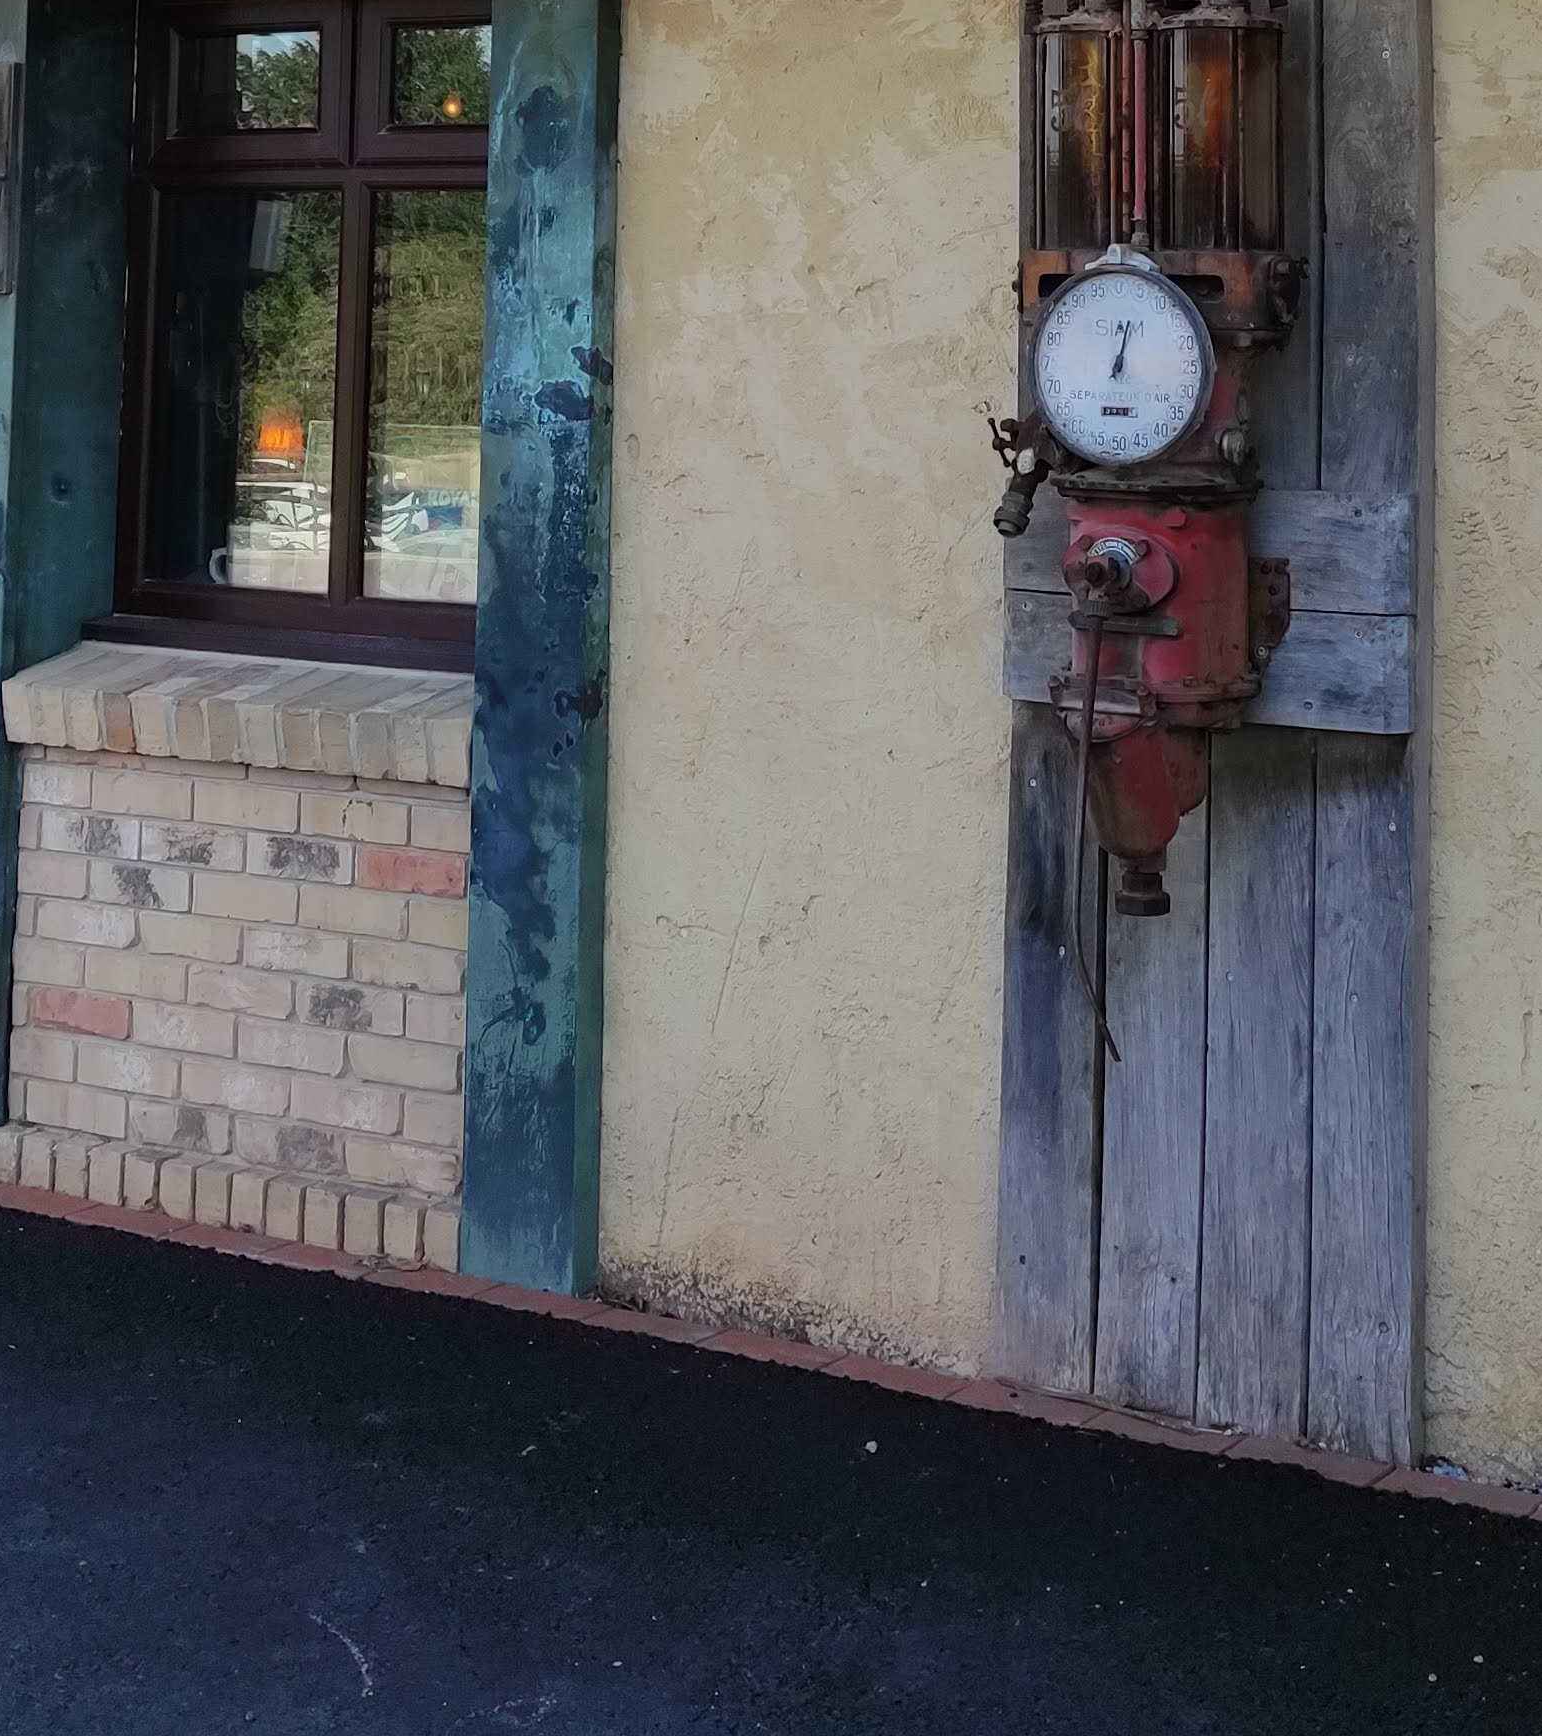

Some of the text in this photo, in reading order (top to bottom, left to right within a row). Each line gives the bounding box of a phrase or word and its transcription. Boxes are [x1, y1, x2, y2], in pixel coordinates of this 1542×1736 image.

[1090, 282, 1105, 298] 95
[1115, 279, 1123, 295] 0
[1071, 293, 1086, 308] 90
[1154, 294, 1166, 310] 10
[1056, 310, 1071, 325] 85
[1047, 331, 1061, 346] 80
[1179, 335, 1194, 351] 20
[1183, 359, 1198, 375] 25
[1047, 379, 1061, 394] 70
[1179, 384, 1194, 399] 30
[1056, 401, 1070, 417] 65
[1169, 405, 1184, 421] 35
[1153, 422, 1168, 438] 40
[1112, 435, 1127, 451] 50
[1133, 432, 1148, 448] 45
